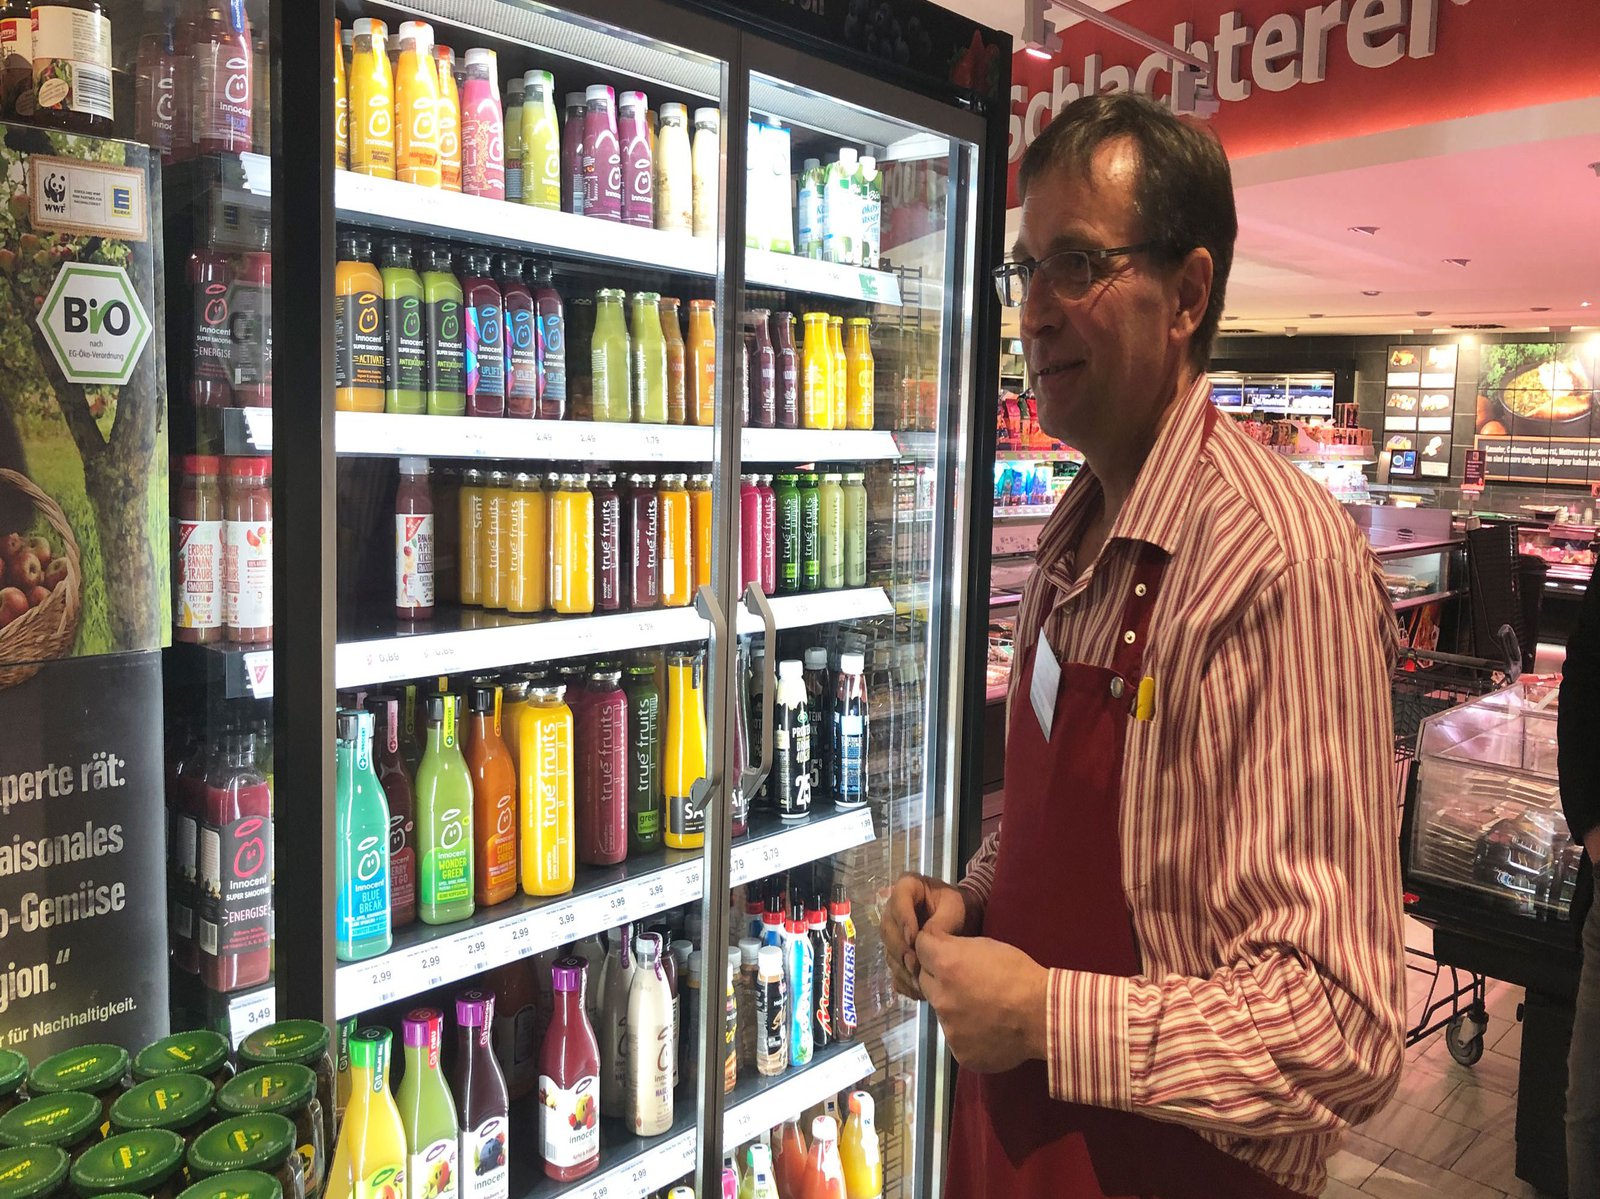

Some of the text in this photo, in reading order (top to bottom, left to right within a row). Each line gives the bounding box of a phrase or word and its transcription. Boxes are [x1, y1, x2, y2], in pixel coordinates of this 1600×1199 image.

[45, 204, 65, 213] WWF
[600, 501, 610, 537] fruits
[646, 501, 656, 536] fruits
[188, 544, 213, 556] ERDBEER
[188, 557, 212, 568] BANANE
[188, 569, 212, 580] TRAUBE
[636, 698, 649, 747] fruits
[599, 706, 613, 754] fruits
[541, 723, 556, 776] fruits
[0, 751, 125, 815] perte rät:
[438, 849, 466, 859] innocent
[763, 848, 779, 861] 3,79
[438, 857, 467, 870] WONDER
[442, 868, 464, 880] GREEN
[686, 873, 700, 884] 3,99
[230, 874, 268, 890] innocent
[355, 879, 385, 892] innocent
[362, 889, 380, 901] BLUE
[649, 885, 664, 896] 3,99
[226, 893, 244, 902] SUPER
[610, 897, 626, 909] 3,99
[359, 899, 383, 914] BREAK
[229, 904, 268, 923] ENERGISE
[558, 913, 575, 926] 3,99
[512, 927, 529, 940] 2,99
[467, 941, 486, 954] 2,99
[421, 955, 441, 969] 2,99
[372, 970, 392, 984] 2,99
[843, 943, 857, 1025] SNICKERS
[8, 996, 137, 1045] für Nachhaltigkeit.
[248, 1007, 270, 1024] 3,49
[633, 1168, 647, 1182] 2,99
